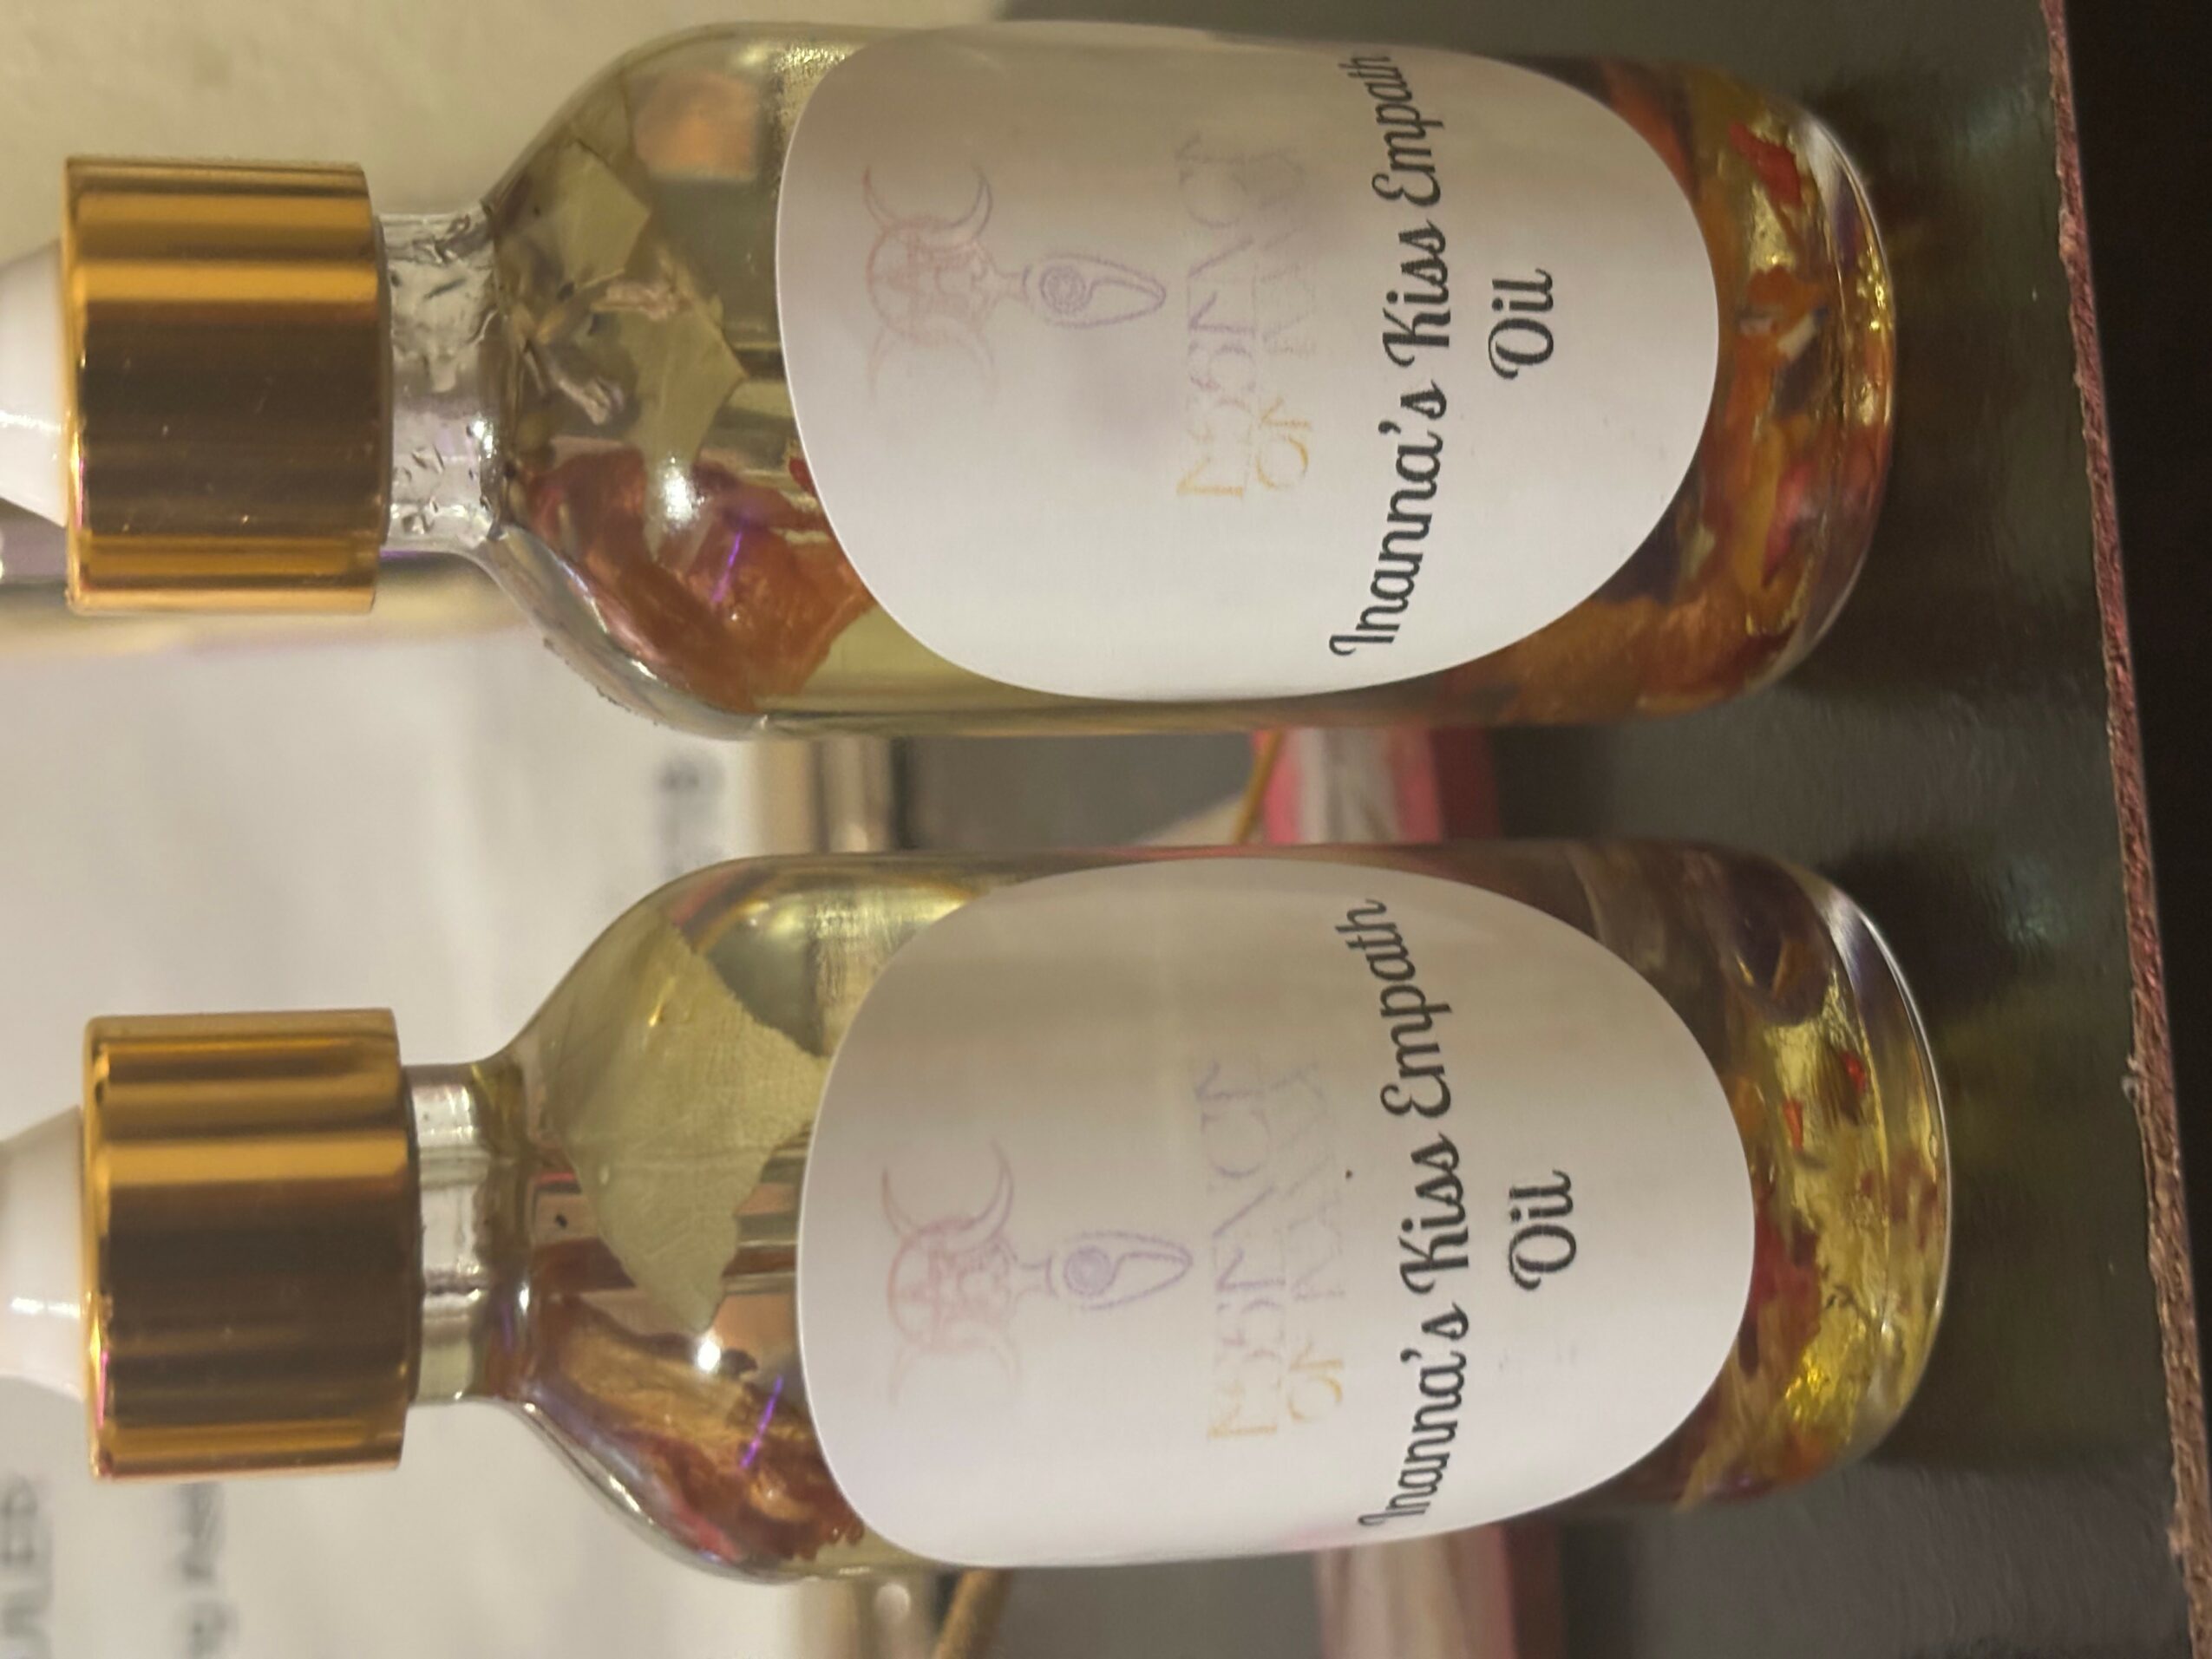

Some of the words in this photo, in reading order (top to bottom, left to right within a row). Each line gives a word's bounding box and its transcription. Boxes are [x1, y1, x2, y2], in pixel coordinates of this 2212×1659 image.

[1337, 54, 1445, 207] Empath
[1381, 217, 1451, 368] Kiss
[1487, 266, 1555, 380] Oil
[1328, 379, 1448, 656] Inanna's
[1333, 897, 1453, 1119] Empath
[1397, 1131, 1470, 1295] Kiss
[1506, 1168, 1578, 1291] Oil
[1356, 1302, 1469, 1526] Inanna's
